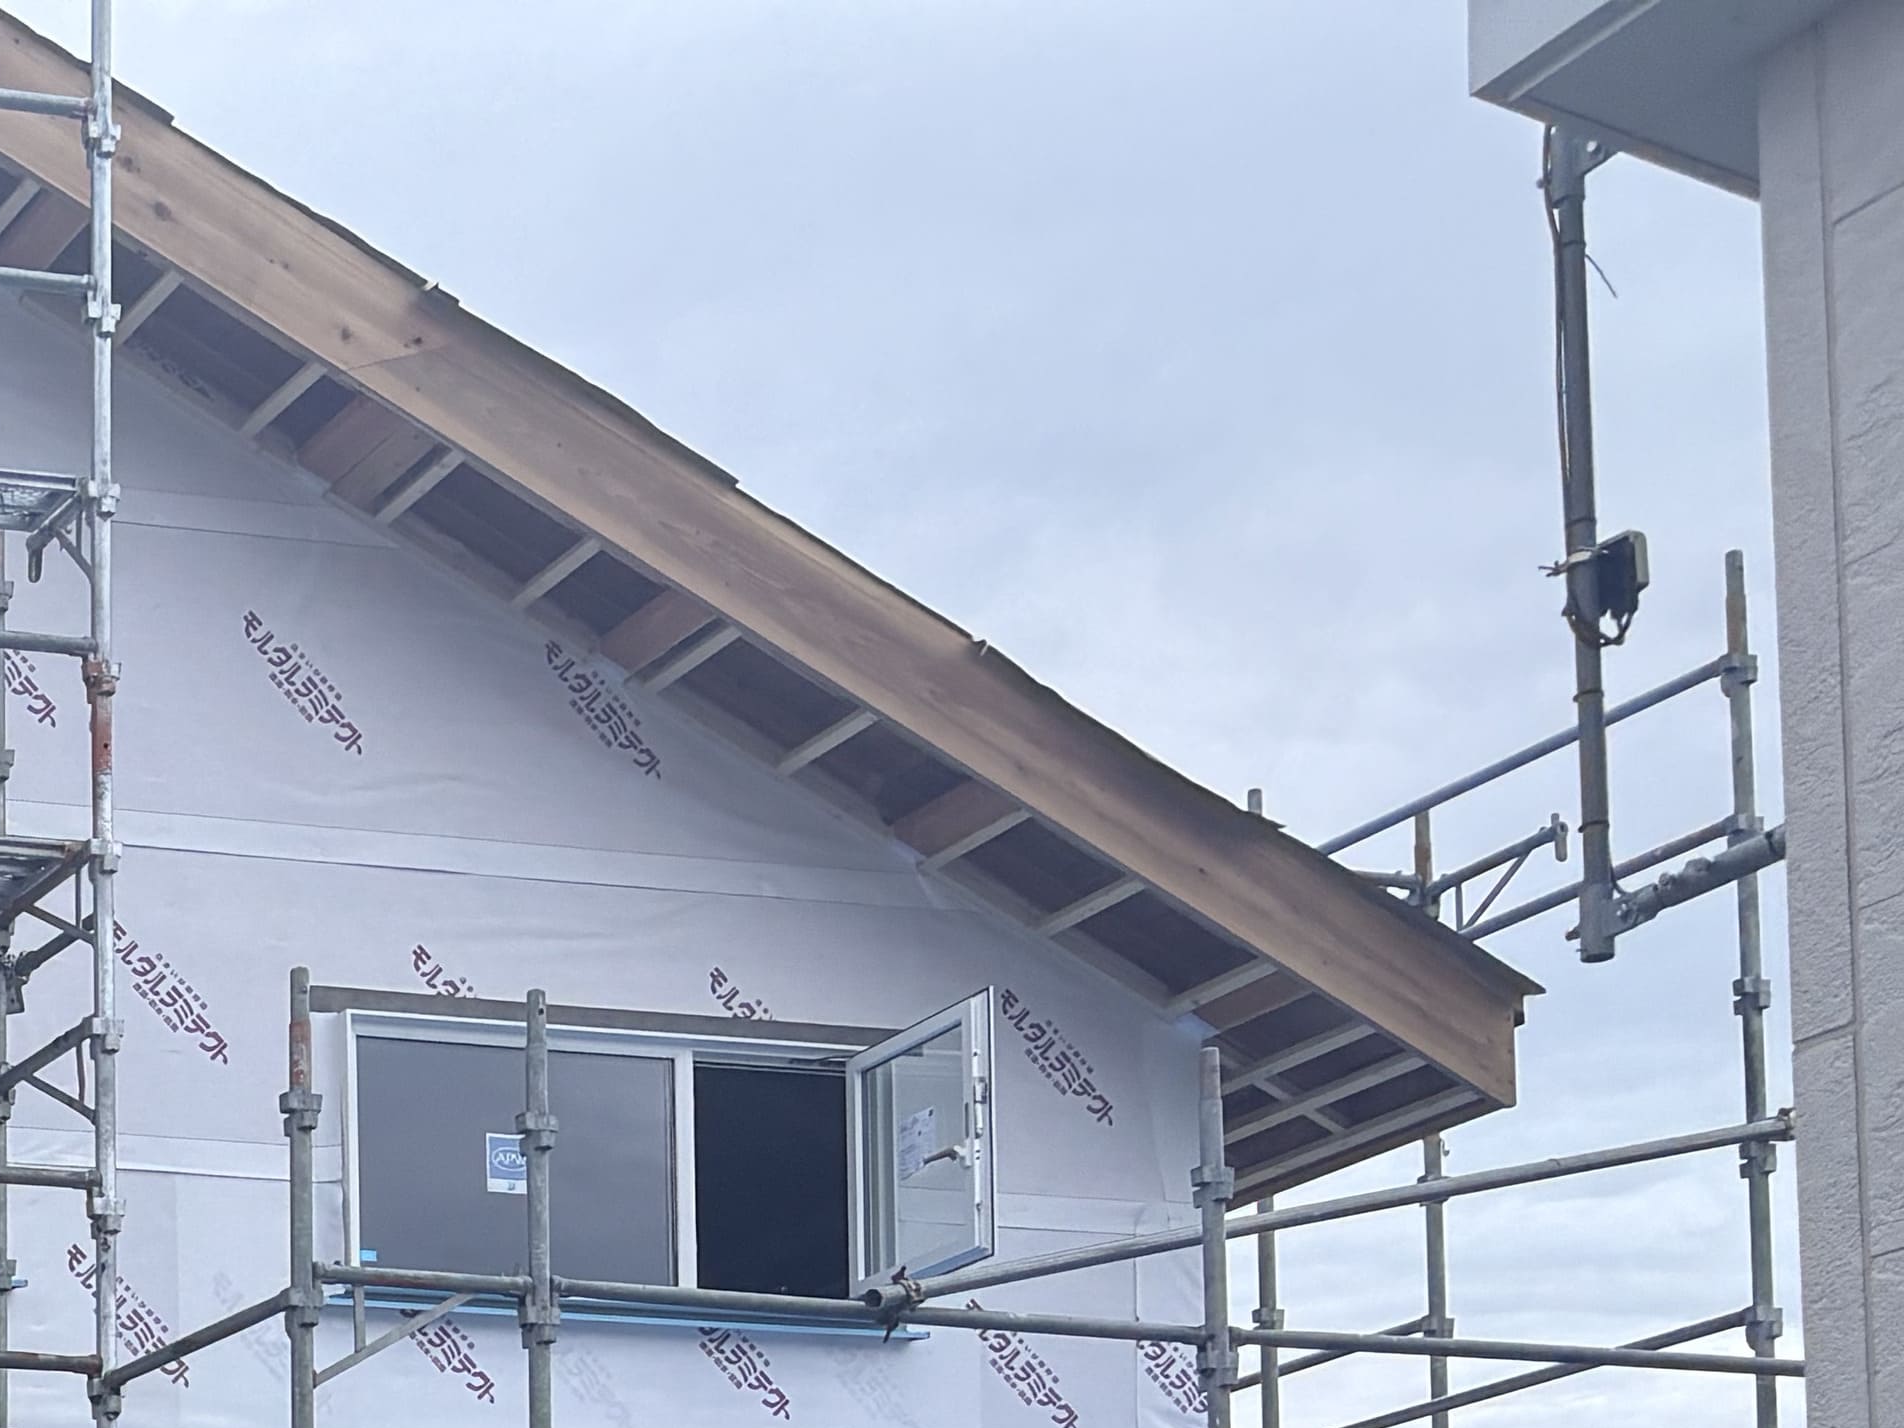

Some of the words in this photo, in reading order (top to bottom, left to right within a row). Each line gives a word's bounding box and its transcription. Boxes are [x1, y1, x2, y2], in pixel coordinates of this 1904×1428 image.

[242, 610, 363, 756] モルタルラミテクト
[998, 988, 1113, 1127] モルタルラミテクト
